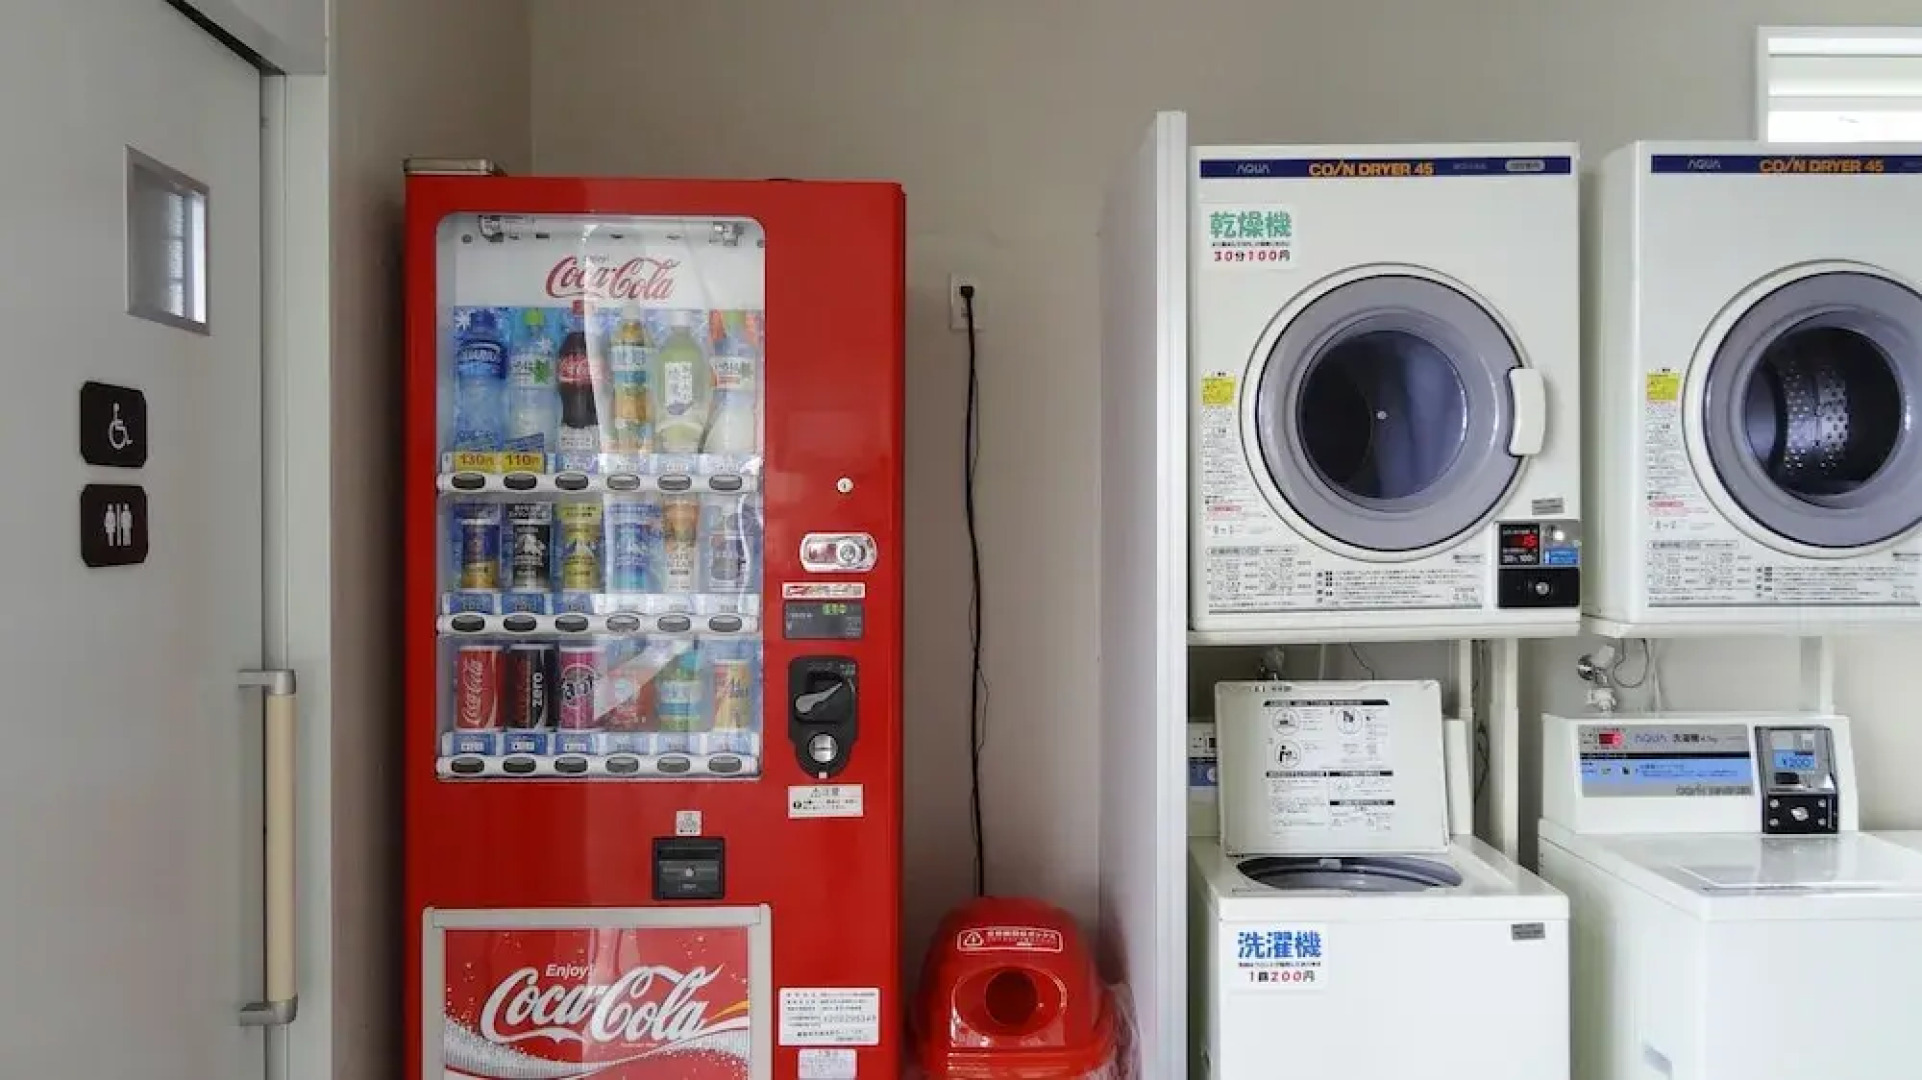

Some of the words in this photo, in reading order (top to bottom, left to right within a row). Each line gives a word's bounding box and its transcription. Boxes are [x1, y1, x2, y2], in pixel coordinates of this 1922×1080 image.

[1235, 164, 1270, 174] AQUA
[1359, 163, 1411, 176] DRYER
[1413, 163, 1435, 176] 45
[1687, 159, 1721, 170] AQUA
[1809, 159, 1861, 172] DRYER
[1863, 159, 1884, 172] 45
[1210, 210, 1293, 239] 乾燥機
[1214, 250, 1291, 262] 30分100円
[532, 671, 543, 708] zero
[1237, 930, 1322, 959] 洗濯機
[545, 963, 597, 978] Enjoy!
[480, 963, 724, 1044] Coca-Cola
